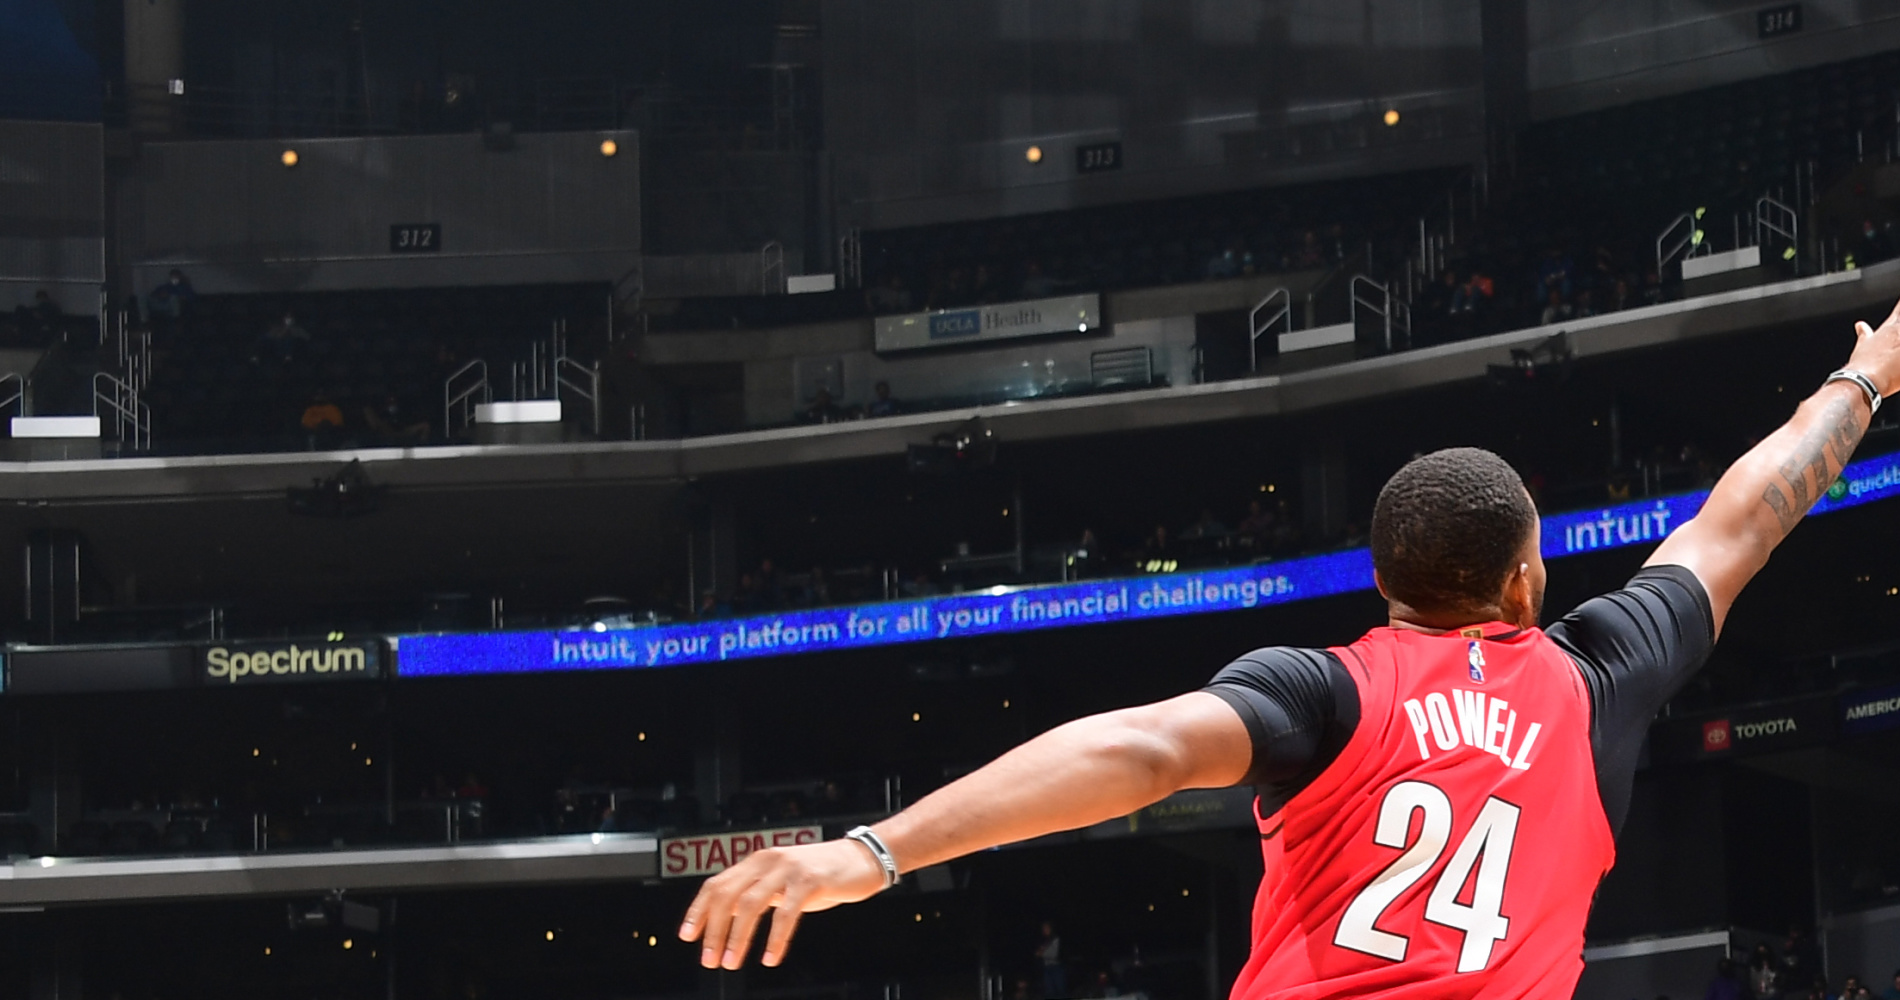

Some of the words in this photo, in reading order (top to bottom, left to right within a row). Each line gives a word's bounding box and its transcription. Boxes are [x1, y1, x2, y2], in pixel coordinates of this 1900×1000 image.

[399, 229, 432, 247] 312
[936, 319, 974, 333] UCLA
[986, 309, 1042, 329] Health
[552, 636, 635, 665] Intuit,
[647, 634, 711, 667] your
[720, 619, 838, 660] platform
[847, 611, 887, 639] for
[896, 606, 928, 633] all
[937, 604, 1004, 638] your
[1011, 587, 1128, 622] financial
[1138, 575, 1294, 608] challenges.
[207, 645, 365, 683] Spectrum
[1404, 688, 1542, 770] POWELL
[1735, 717, 1798, 740] TOYOTA
[1333, 779, 1522, 974] 24
